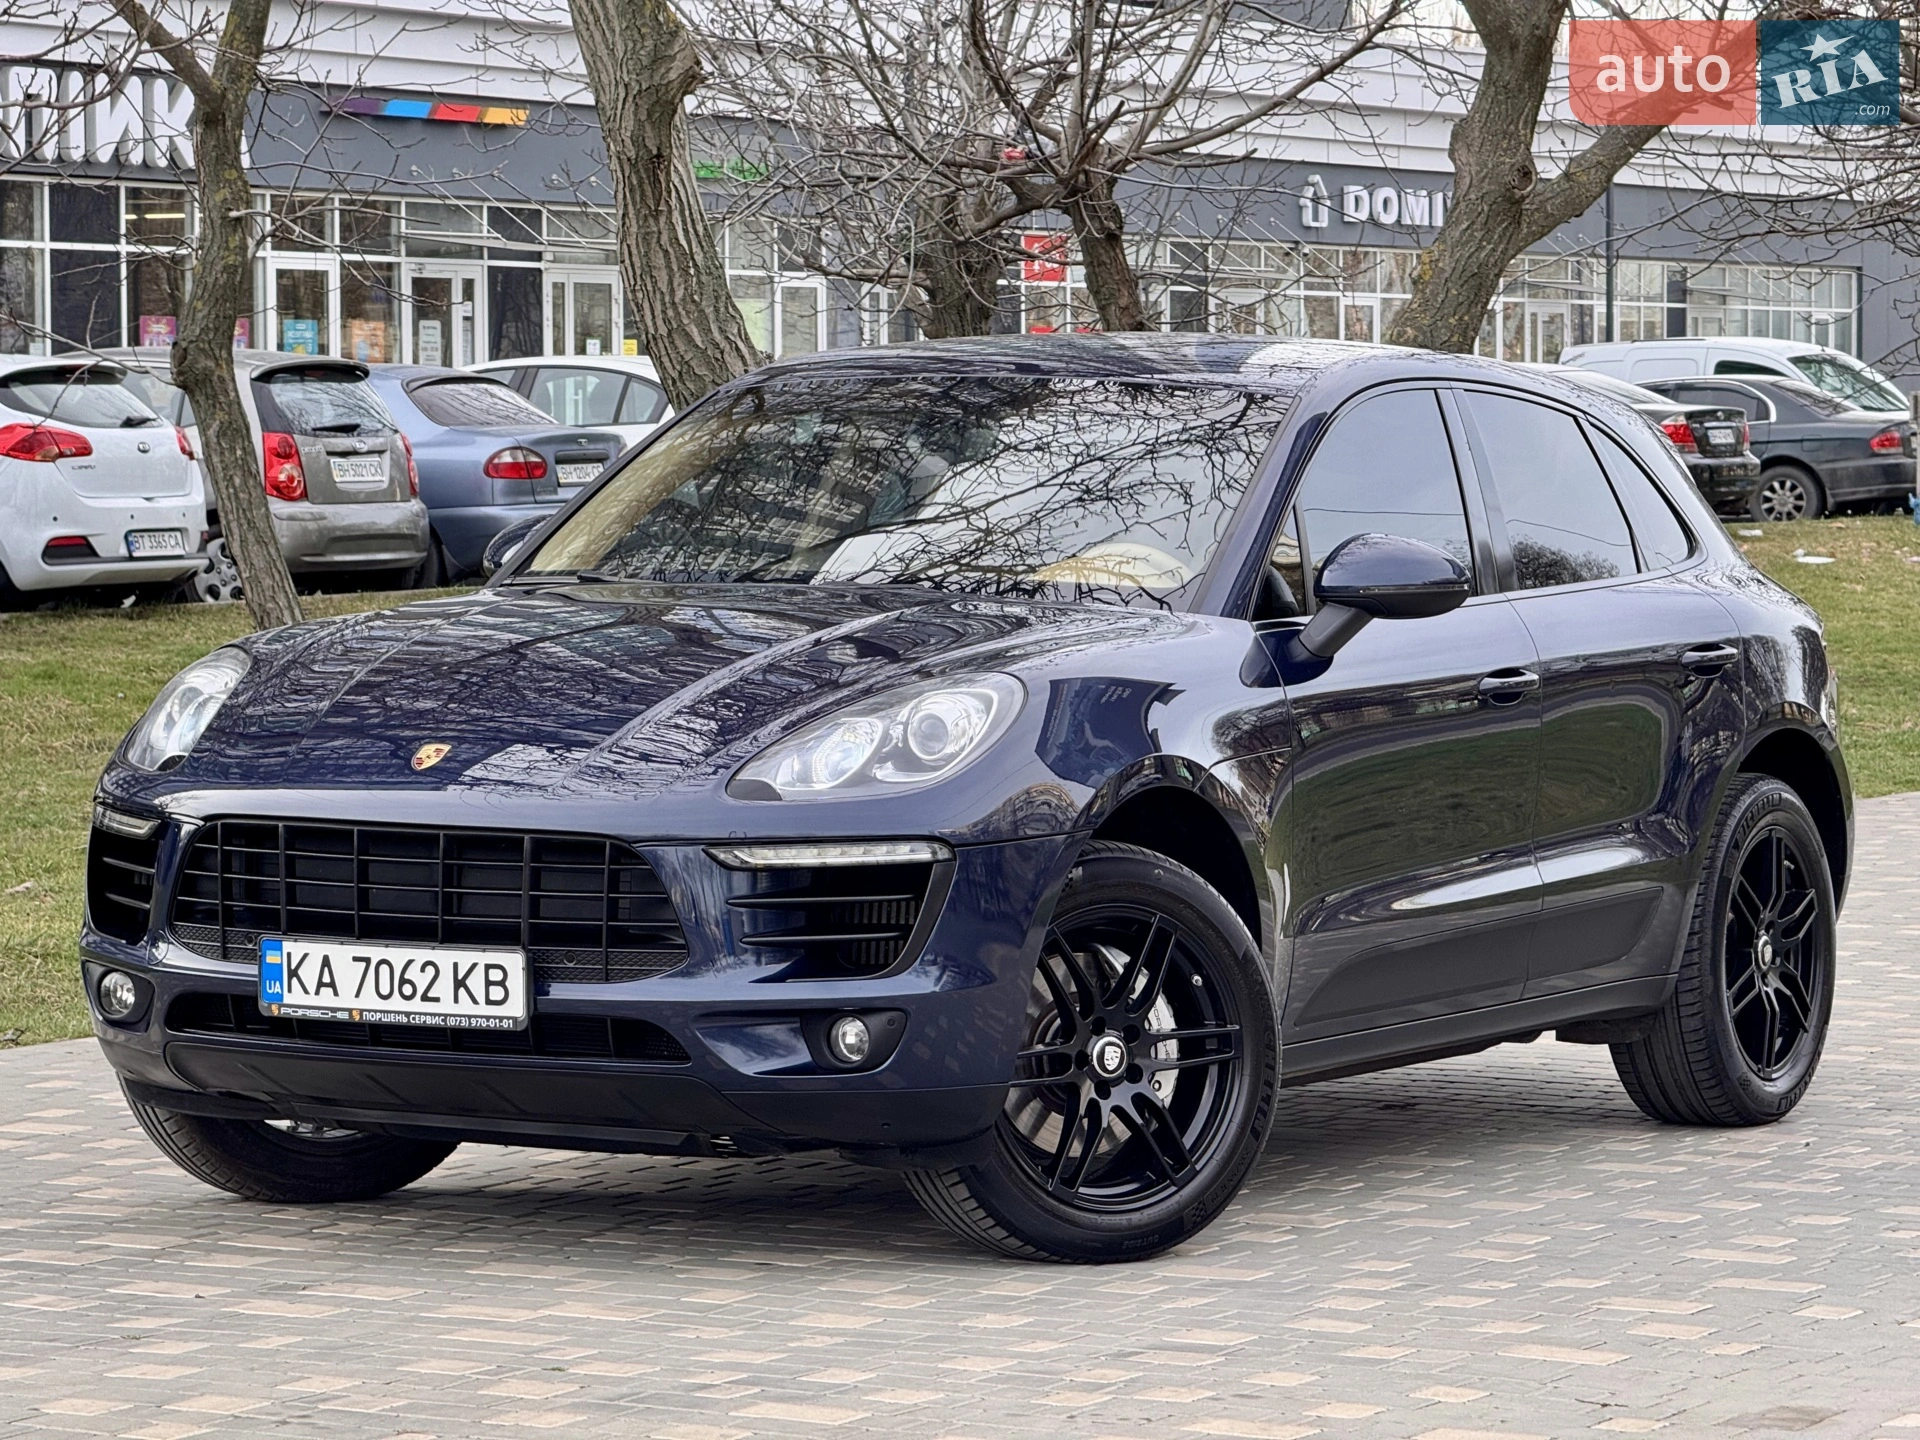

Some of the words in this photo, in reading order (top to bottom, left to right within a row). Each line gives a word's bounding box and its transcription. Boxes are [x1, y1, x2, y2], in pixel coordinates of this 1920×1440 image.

[1343, 184, 1453, 227] DOMI
[133, 534, 146, 550] BT
[167, 533, 181, 549] CA
[266, 980, 282, 994] UA
[286, 951, 339, 997] KA
[351, 956, 441, 1003] 7062
[452, 961, 510, 1006] KB
[280, 1007, 349, 1019] PORSCHE
[362, 1011, 409, 1023] ПОРШЕНЬ
[409, 1014, 445, 1025] СЕРВИС
[446, 1015, 469, 1027] (073)
[470, 1016, 514, 1028] 970-01-01
